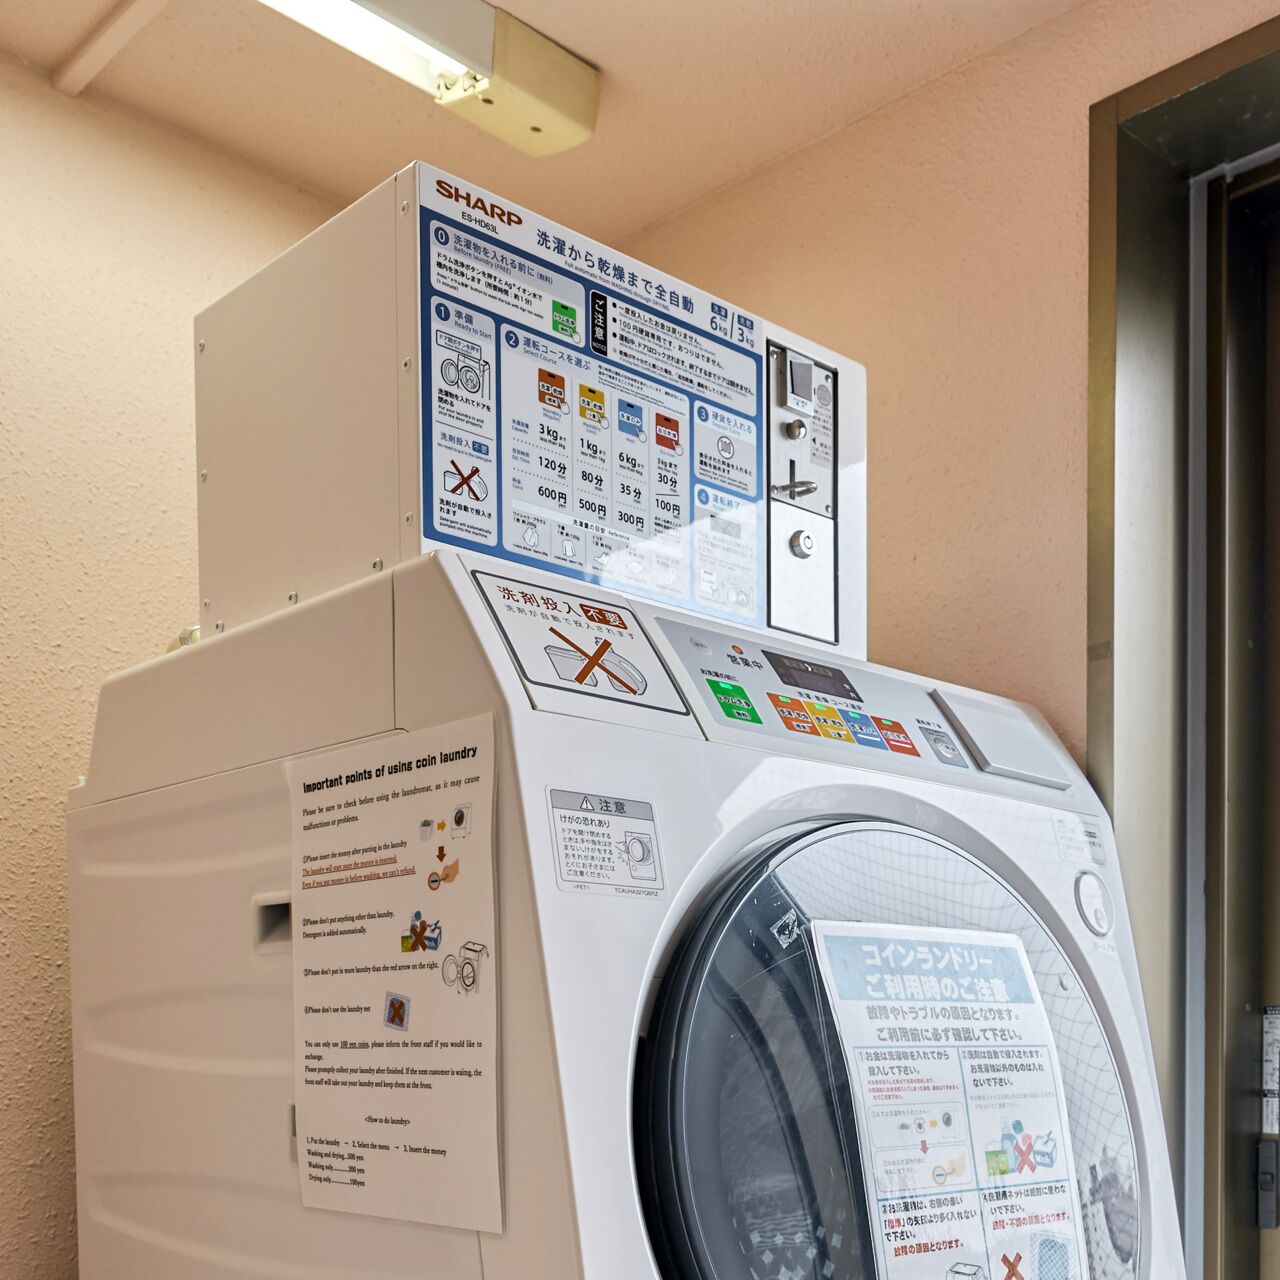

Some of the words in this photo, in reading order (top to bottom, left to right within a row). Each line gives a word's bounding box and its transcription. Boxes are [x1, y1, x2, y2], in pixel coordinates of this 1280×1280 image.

[436, 180, 522, 226] SHARP
[462, 211, 499, 235] ES-HD63L
[537, 229, 694, 314] 洗濯から乾燥まで全自動
[455, 309, 473, 325] 準備
[596, 299, 604, 340] ご注意
[455, 320, 471, 333] Ready
[473, 327, 478, 335] to
[480, 330, 491, 339] Start
[523, 337, 591, 370] 運転コースを選ぶ
[440, 432, 470, 449] 洗剤投入
[538, 486, 567, 505] 600円
[579, 500, 607, 517] 500円
[618, 511, 644, 528] 300円
[497, 585, 581, 617] 洗剤投入
[586, 608, 622, 628] 不要
[505, 604, 634, 640] 洗剤が自動で投入されます
[727, 653, 763, 670] 営業中
[303, 774, 342, 793] Important
[346, 769, 372, 785] points
[376, 765, 385, 778] of
[388, 761, 412, 774] using
[416, 755, 436, 768] coin
[440, 746, 477, 764] laundry
[344, 799, 357, 808] check
[359, 796, 374, 805] before
[376, 793, 389, 802] using
[391, 790, 399, 799] the
[444, 780, 447, 788] it
[450, 779, 462, 787] may
[464, 776, 480, 784] cause
[599, 799, 626, 814] 注意
[303, 820, 330, 831] malfunctions
[337, 816, 359, 826] problems.
[560, 814, 610, 828] けがの恐れあり
[391, 840, 407, 848] laundry
[566, 862, 615, 872] とくにお子さまには
[567, 870, 611, 879] ご注意ください。
[337, 914, 354, 923] anything
[367, 911, 376, 919] than
[862, 944, 993, 971] コインランドリー
[355, 965, 371, 974] laundry
[372, 964, 381, 972] than
[865, 975, 1009, 1002] ご利用時のご注意
[347, 1005, 363, 1014] laundry
[867, 1005, 1020, 1021] 故障やトラブルの原因となります。
[877, 1026, 1022, 1042] ご利用前に必ず確認して下さい。
[322, 1041, 330, 1049] only
[371, 1041, 384, 1049] please
[349, 1067, 358, 1075] your
[359, 1067, 375, 1075] laundry
[474, 1068, 482, 1076] the
[868, 1066, 920, 1076] 投入して下さい。
[970, 1063, 1044, 1073] お洗濯物以外のものは入れ
[358, 1080, 374, 1088] laundry
[384, 1080, 393, 1089] keep
[973, 1078, 1013, 1087] ないで下さい。
[357, 1141, 370, 1149] Select
[409, 1145, 422, 1153] Insert
[431, 1148, 446, 1157] money
[991, 1204, 1024, 1215] いで下さい。
[885, 1230, 916, 1241] で下さい。
